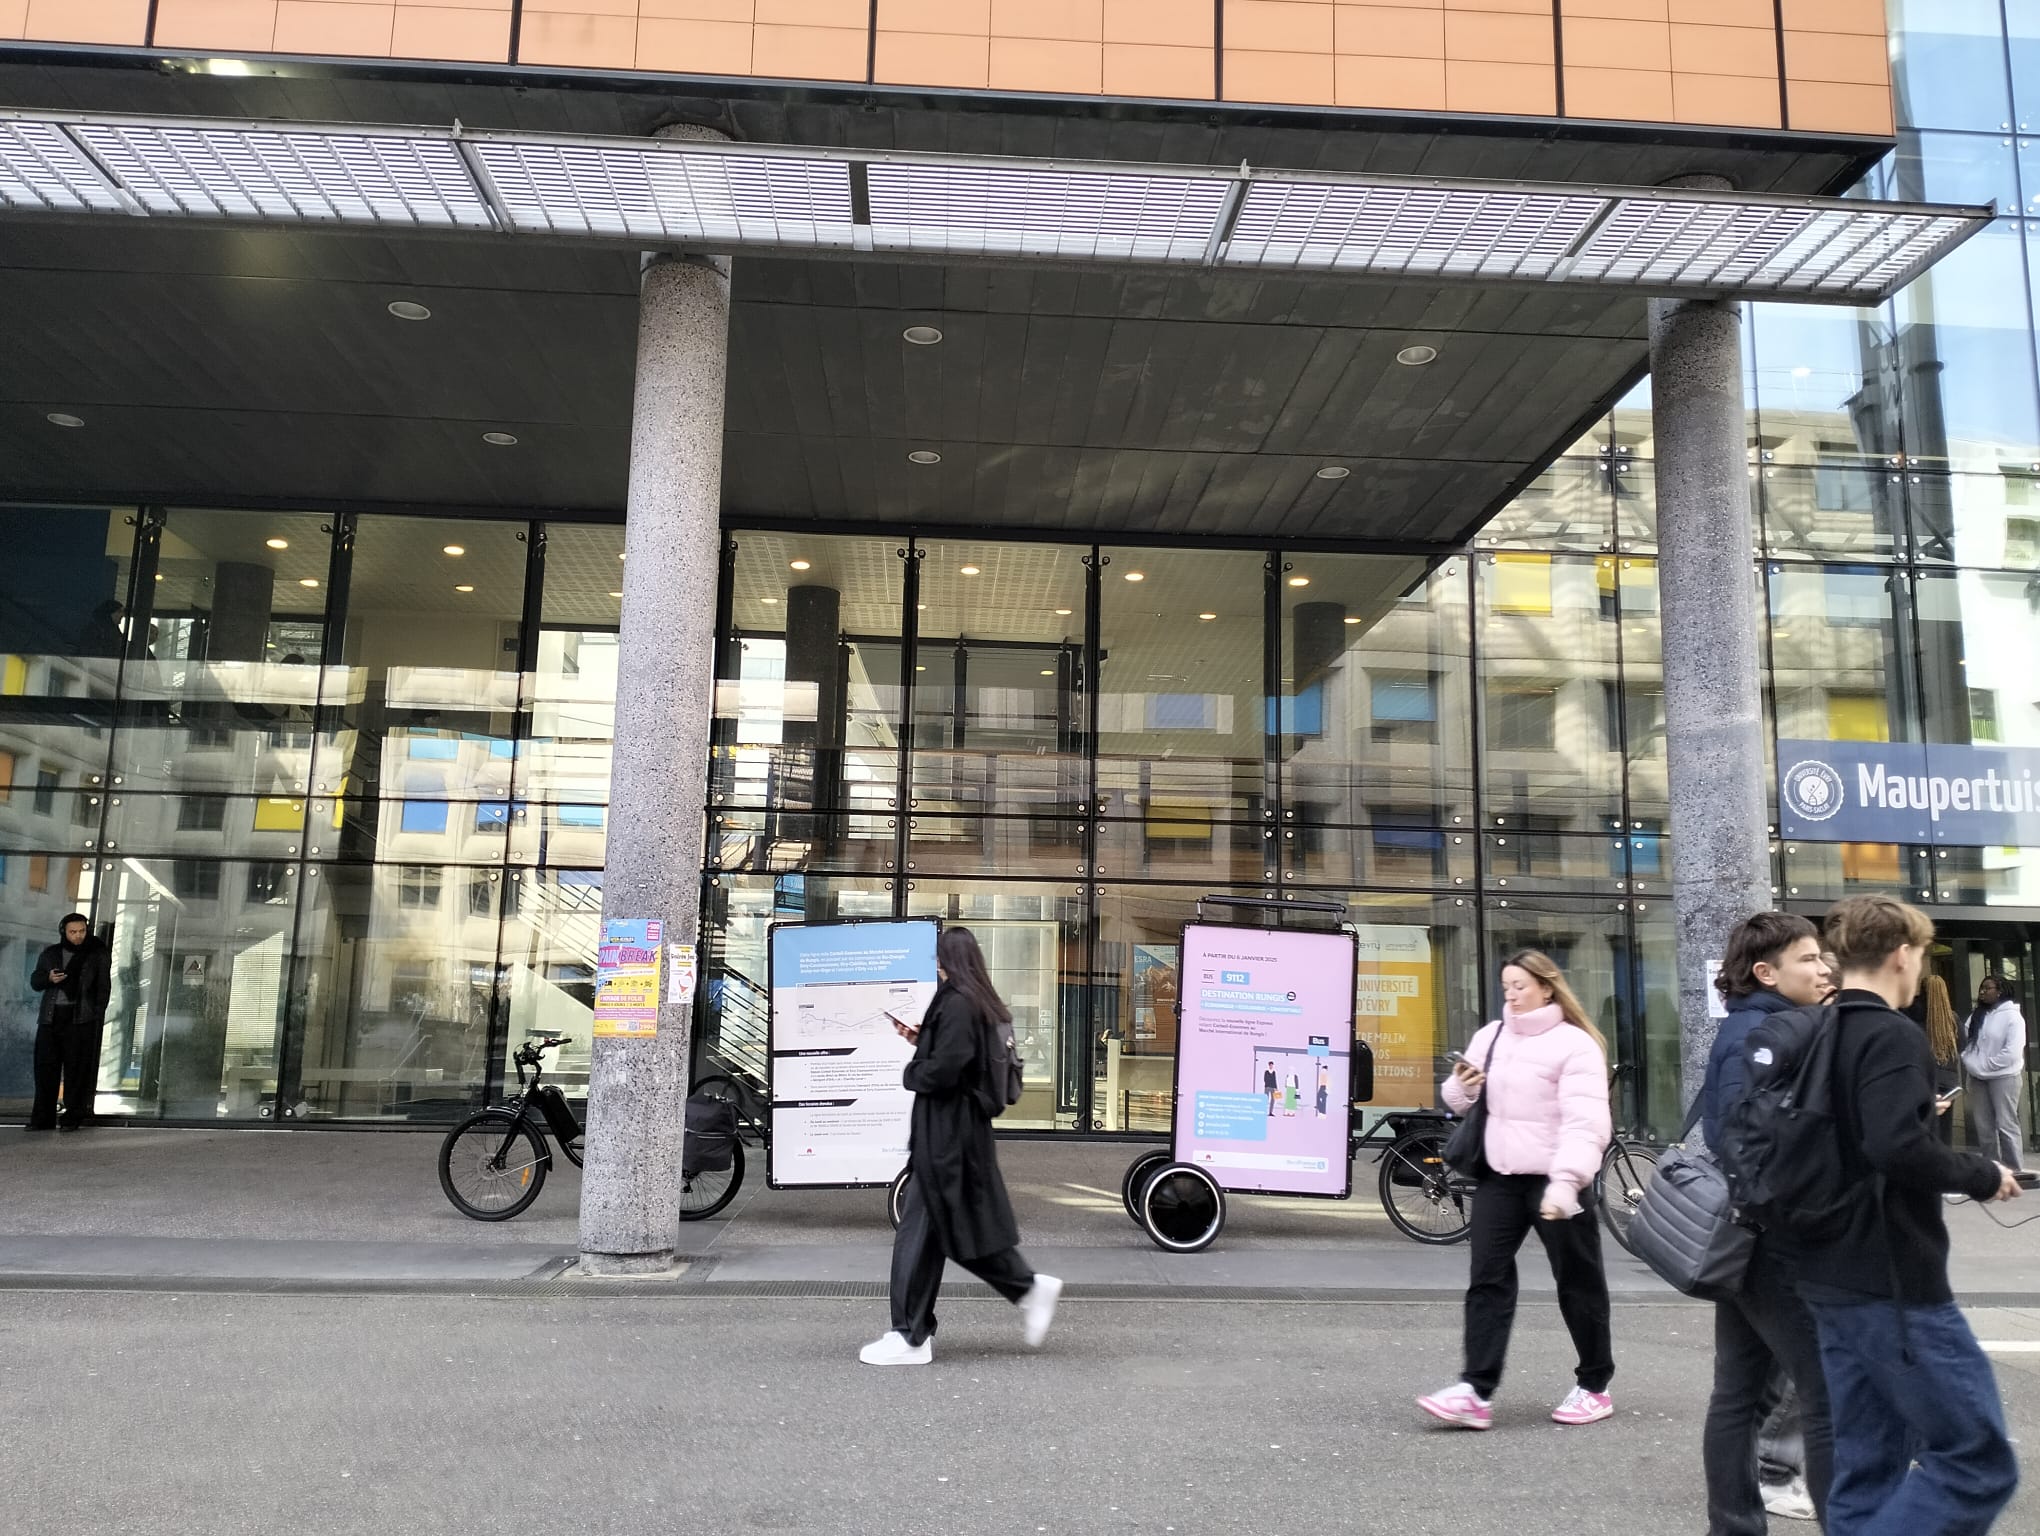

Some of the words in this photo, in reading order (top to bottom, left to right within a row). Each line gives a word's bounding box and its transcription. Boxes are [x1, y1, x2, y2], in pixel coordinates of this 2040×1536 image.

[620, 950, 658, 962] BREAK
[1226, 973, 1245, 983] 9112
[1202, 990, 1255, 1000] DESTINATION
[1256, 993, 1286, 1002] RUNGIS
[1357, 996, 1390, 1012] D'ÉVRY
[1356, 1032, 1406, 1044] TREMPLIN
[1374, 1065, 1414, 1077] ITIONS
